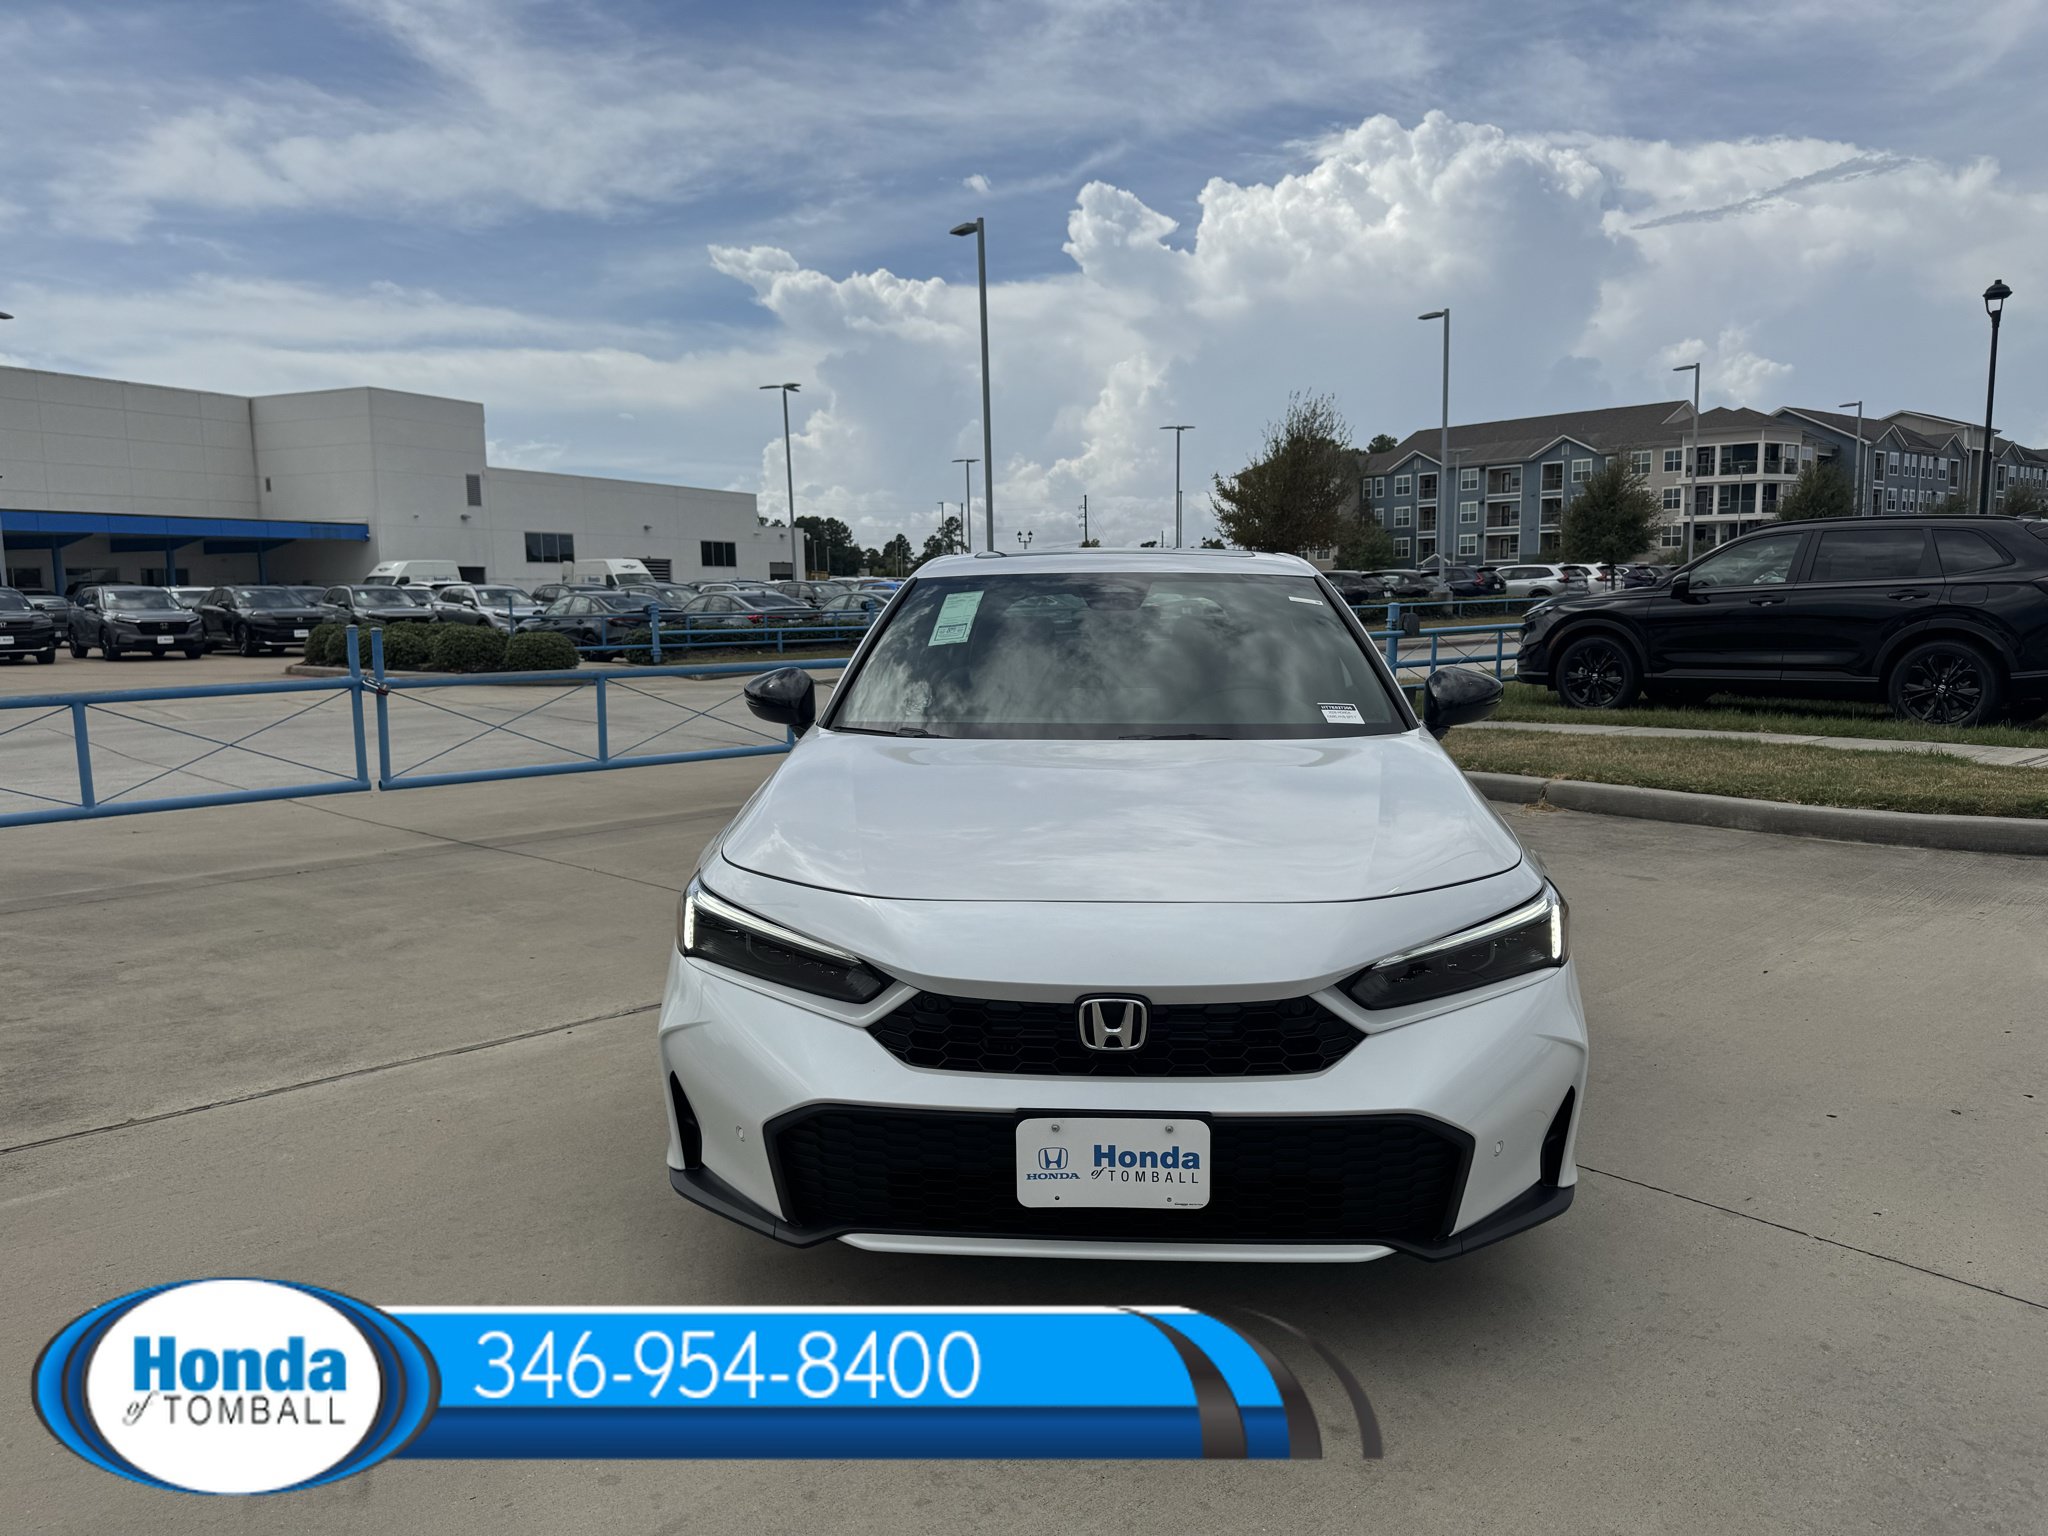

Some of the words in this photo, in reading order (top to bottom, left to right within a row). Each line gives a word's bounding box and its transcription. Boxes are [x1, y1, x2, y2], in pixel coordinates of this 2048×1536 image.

[1093, 1144, 1200, 1169] Honda
[1026, 1172, 1080, 1180] HONDA
[1091, 1167, 1107, 1179] of
[1109, 1170, 1199, 1183] TOMBALL
